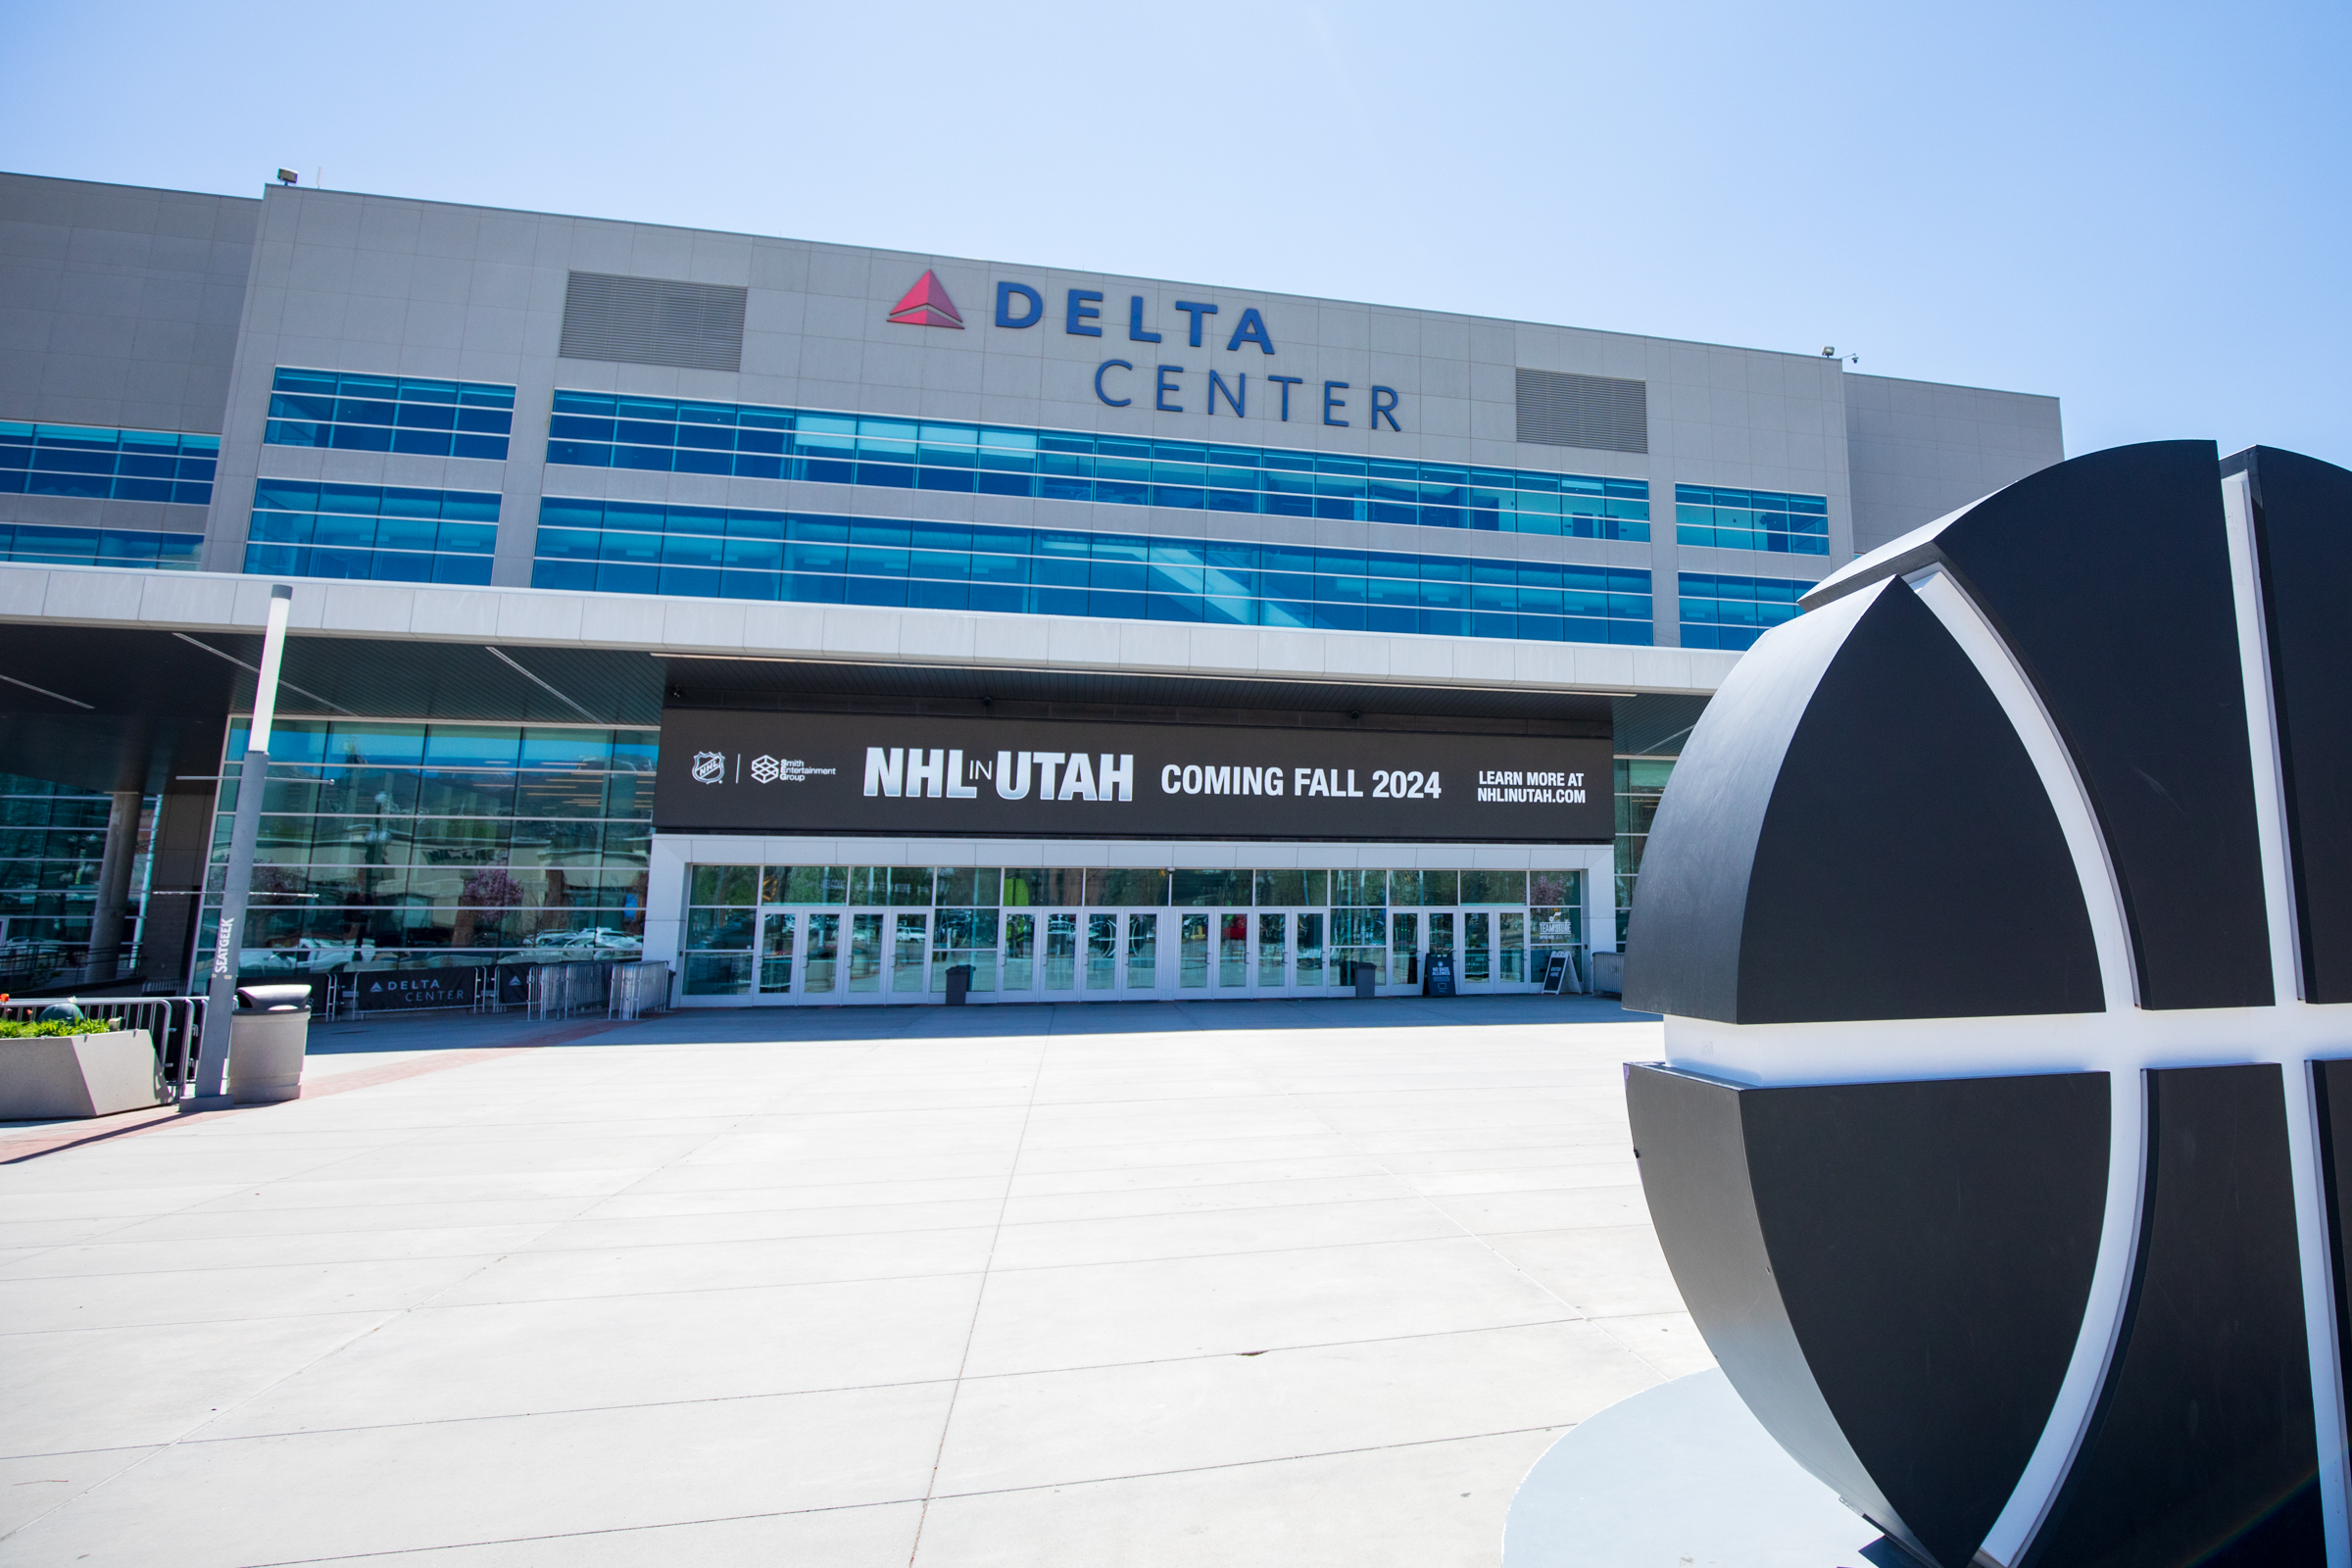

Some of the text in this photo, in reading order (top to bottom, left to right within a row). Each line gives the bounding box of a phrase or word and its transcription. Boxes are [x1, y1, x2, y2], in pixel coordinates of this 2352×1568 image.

[995, 280, 1275, 355] DELTA
[1094, 359, 1401, 432] CENTER
[699, 760, 718, 777] NHL
[780, 759, 805, 767] Smith
[780, 766, 836, 775] Entertainment
[779, 773, 806, 782] Group
[863, 747, 1134, 802] NHL IN UTAH
[1160, 764, 1442, 800] COMING FALL 2024
[1479, 770, 1584, 787] LEARN MORE AT
[1477, 787, 1586, 804] NHLINUTAH.COM
[1540, 923, 1572, 933] TEAM STORE
[215, 917, 235, 973] SEATGEEK
[387, 979, 440, 991] DELTA
[405, 990, 465, 1003] CENTER
